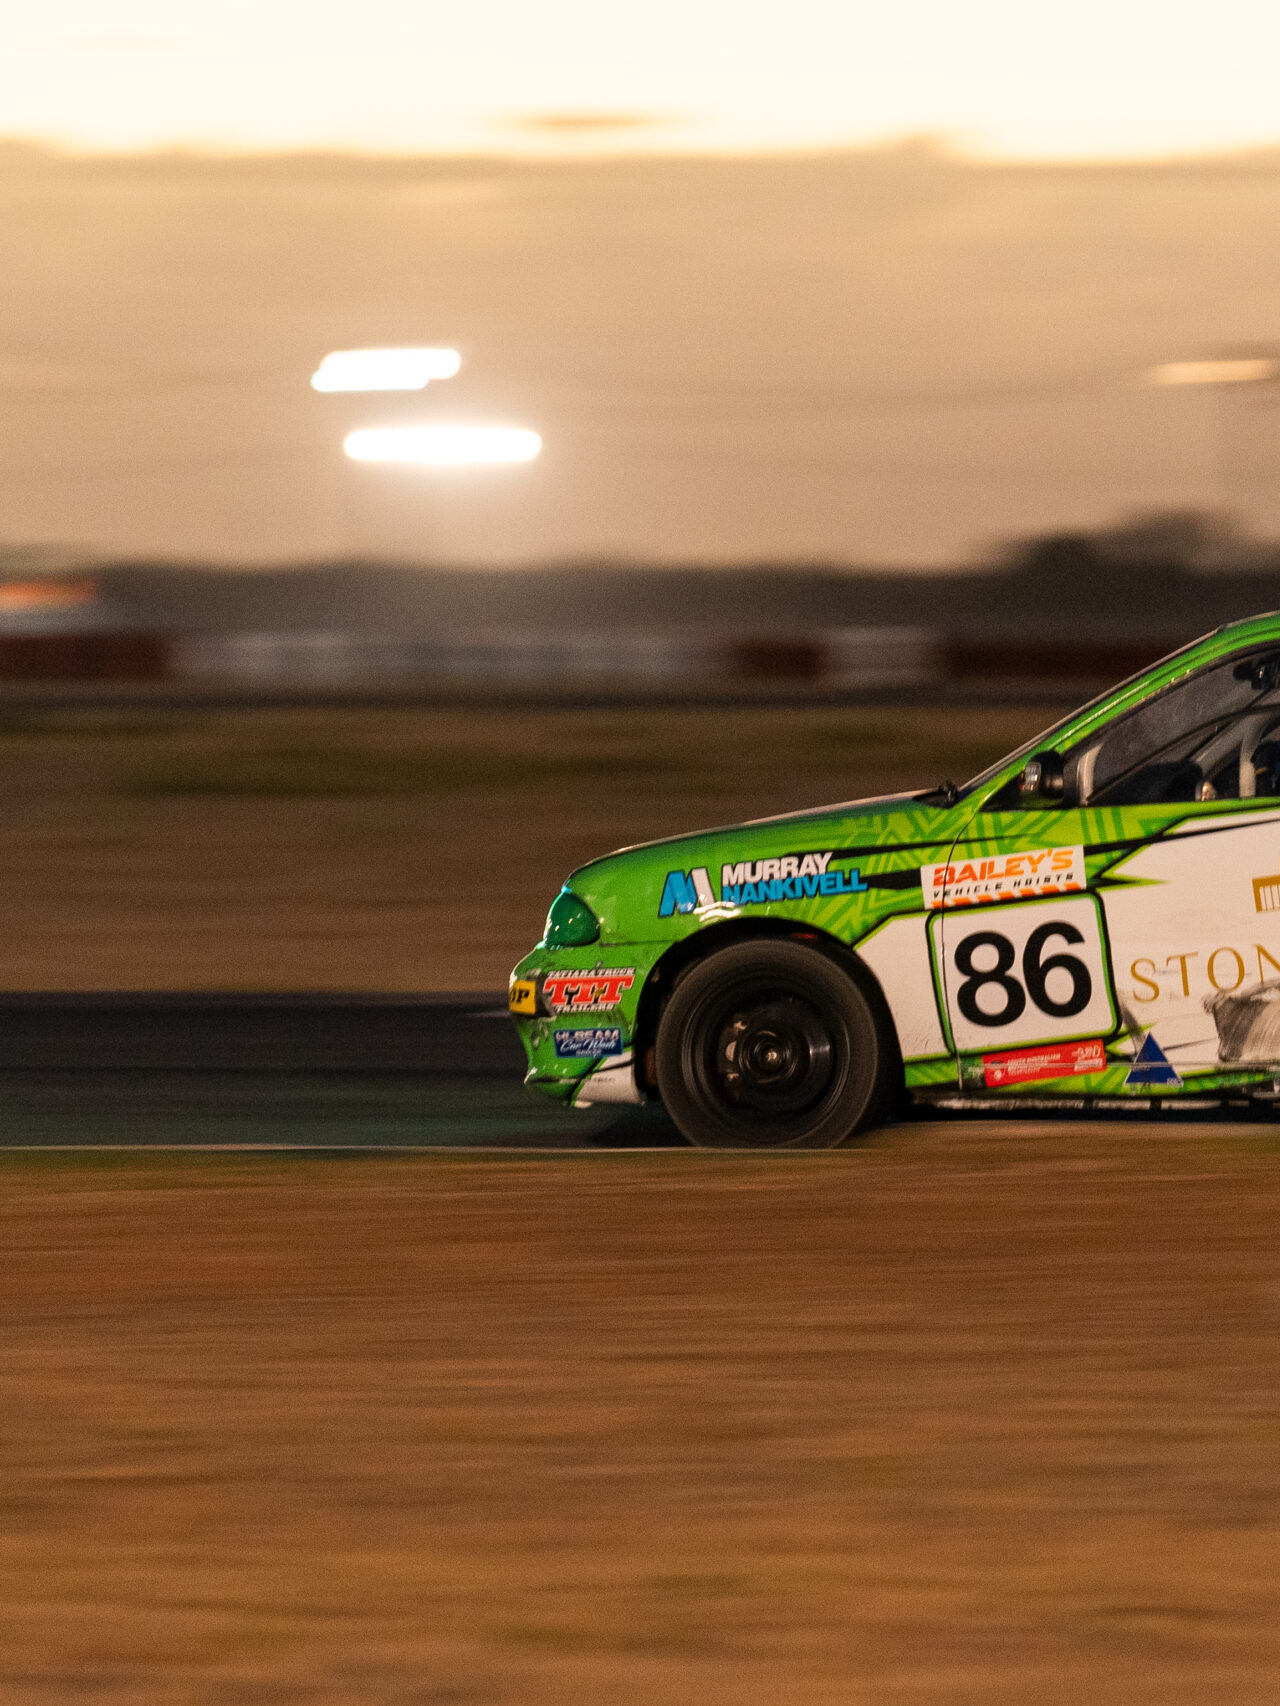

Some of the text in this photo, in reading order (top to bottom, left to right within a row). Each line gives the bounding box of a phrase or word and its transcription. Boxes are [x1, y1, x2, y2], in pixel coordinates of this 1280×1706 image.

[722, 851, 833, 886] MURRAY
[932, 848, 1075, 888] BAILEY'S
[933, 872, 1075, 899] VEHICLE HOISTS
[722, 868, 868, 906] NANKIVELL
[542, 976, 635, 1006] TTT
[954, 920, 1092, 1027] 86
